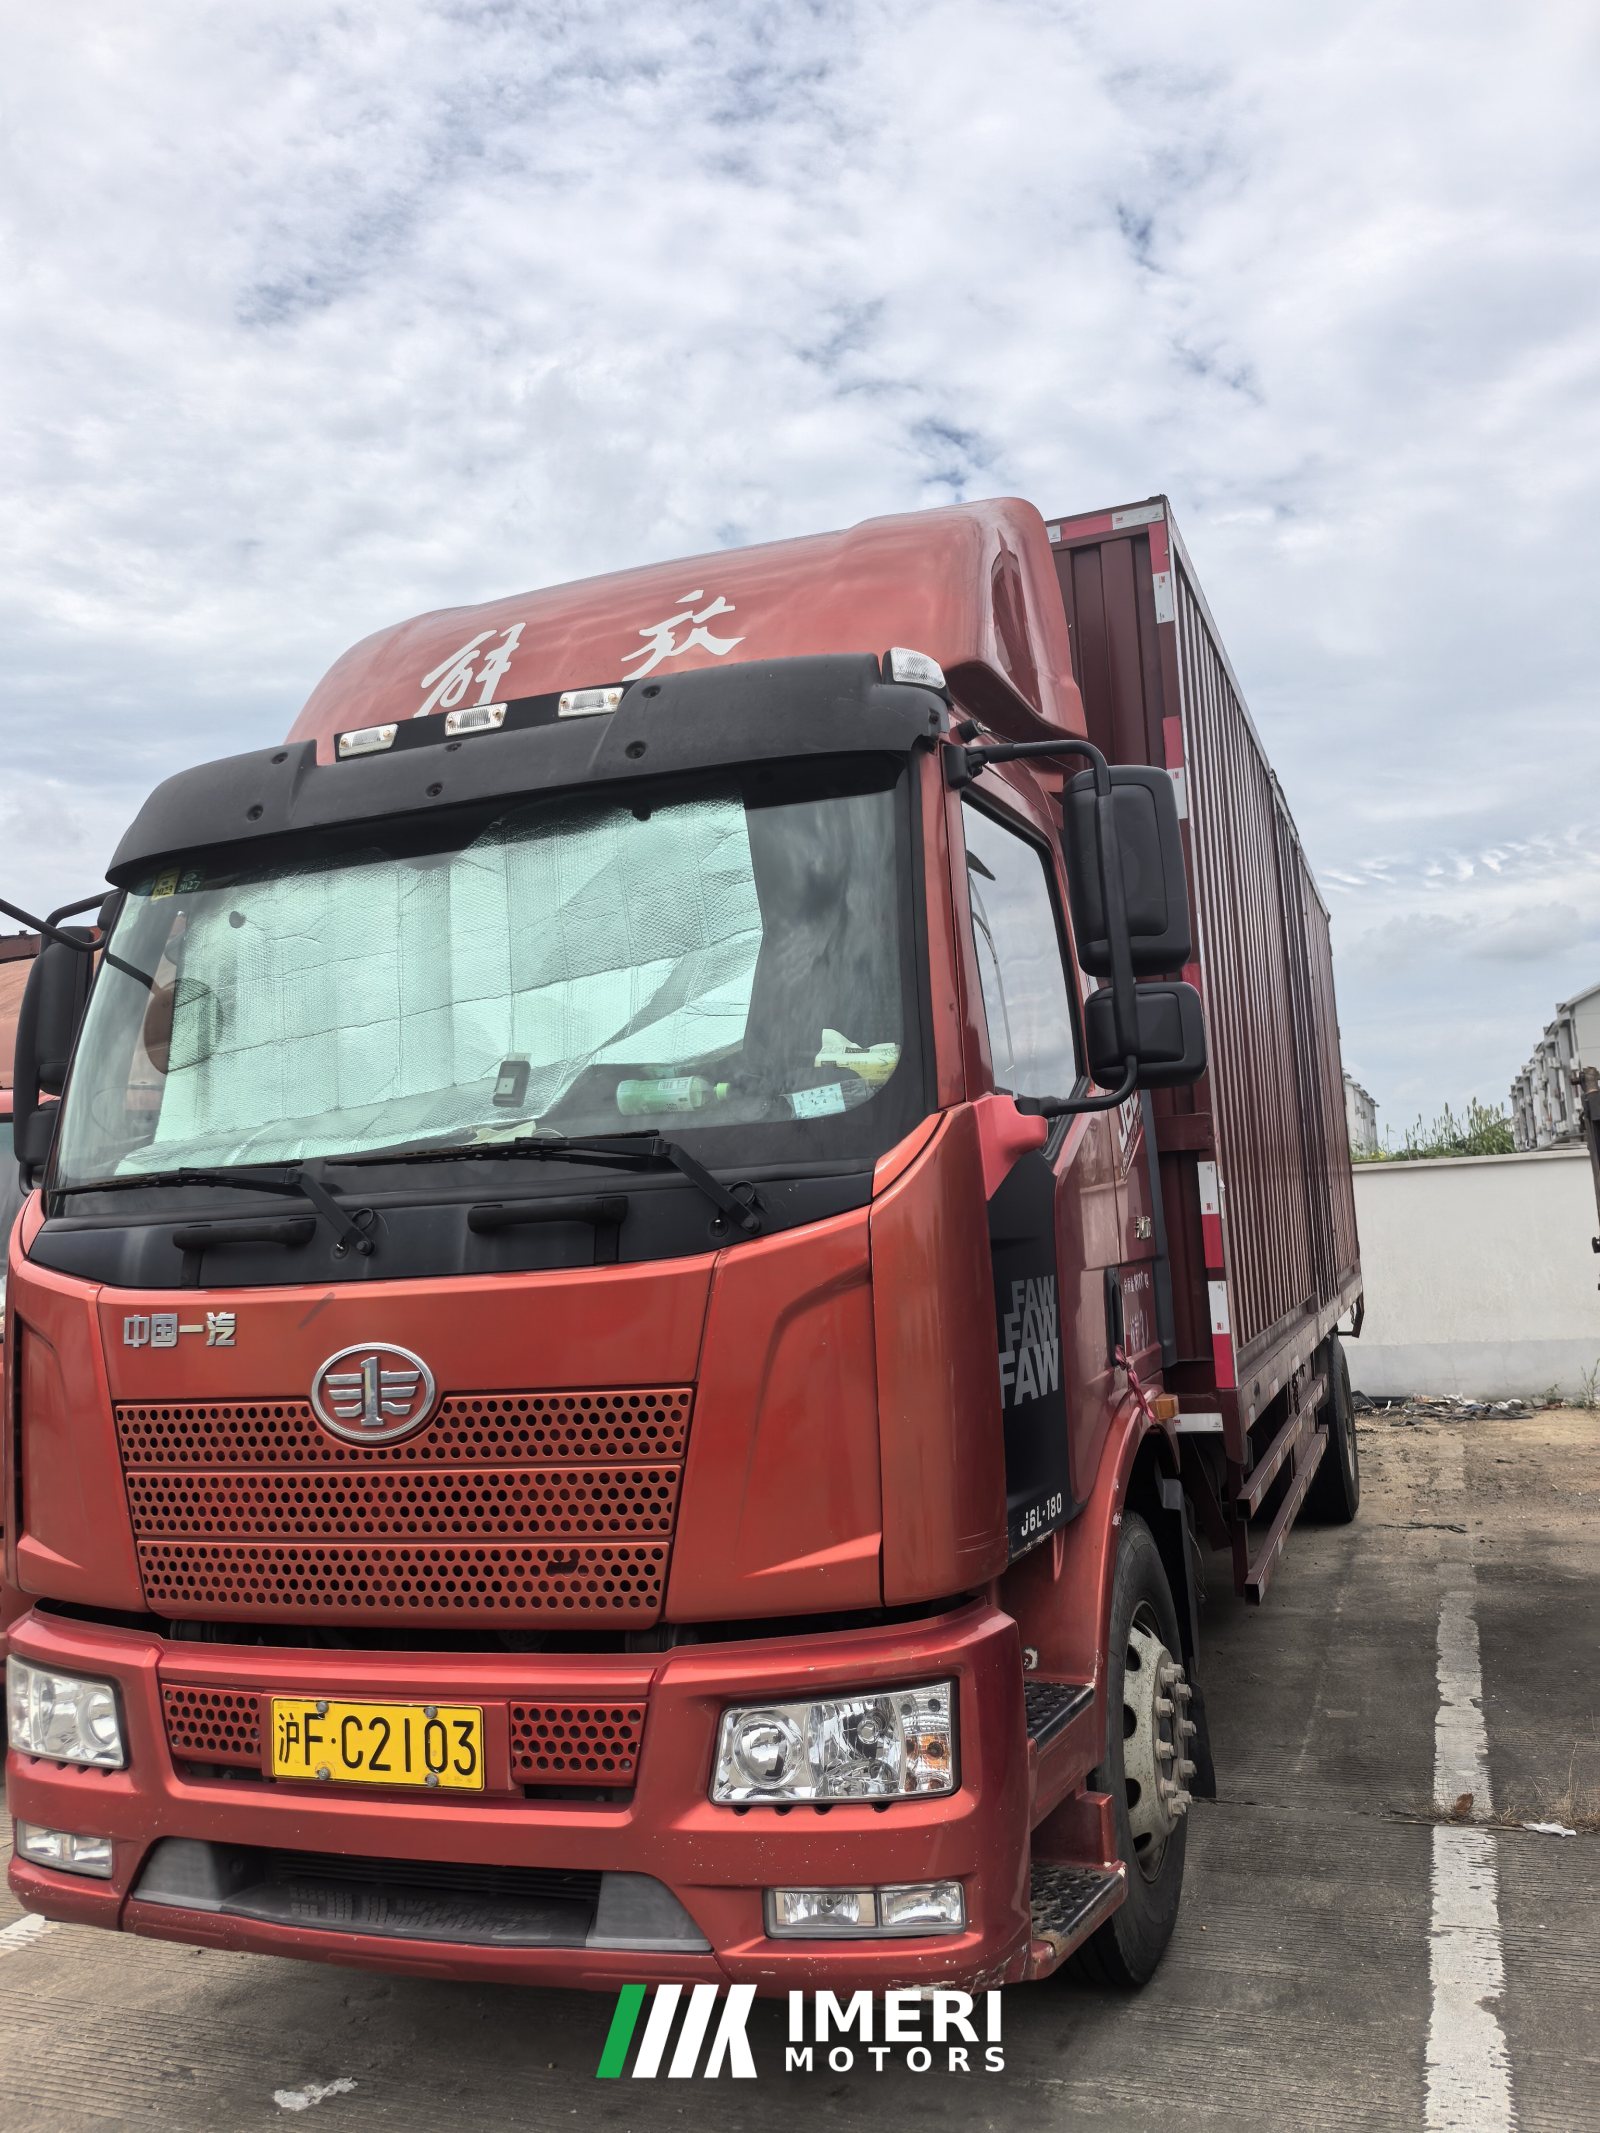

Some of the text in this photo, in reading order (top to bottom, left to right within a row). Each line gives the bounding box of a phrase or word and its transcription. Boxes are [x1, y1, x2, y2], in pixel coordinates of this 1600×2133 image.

[1010, 1274, 1055, 1313] FAW
[123, 1311, 236, 1348] 中国一汽
[1003, 1303, 1057, 1352] FAW
[998, 1338, 1058, 1409] FAW
